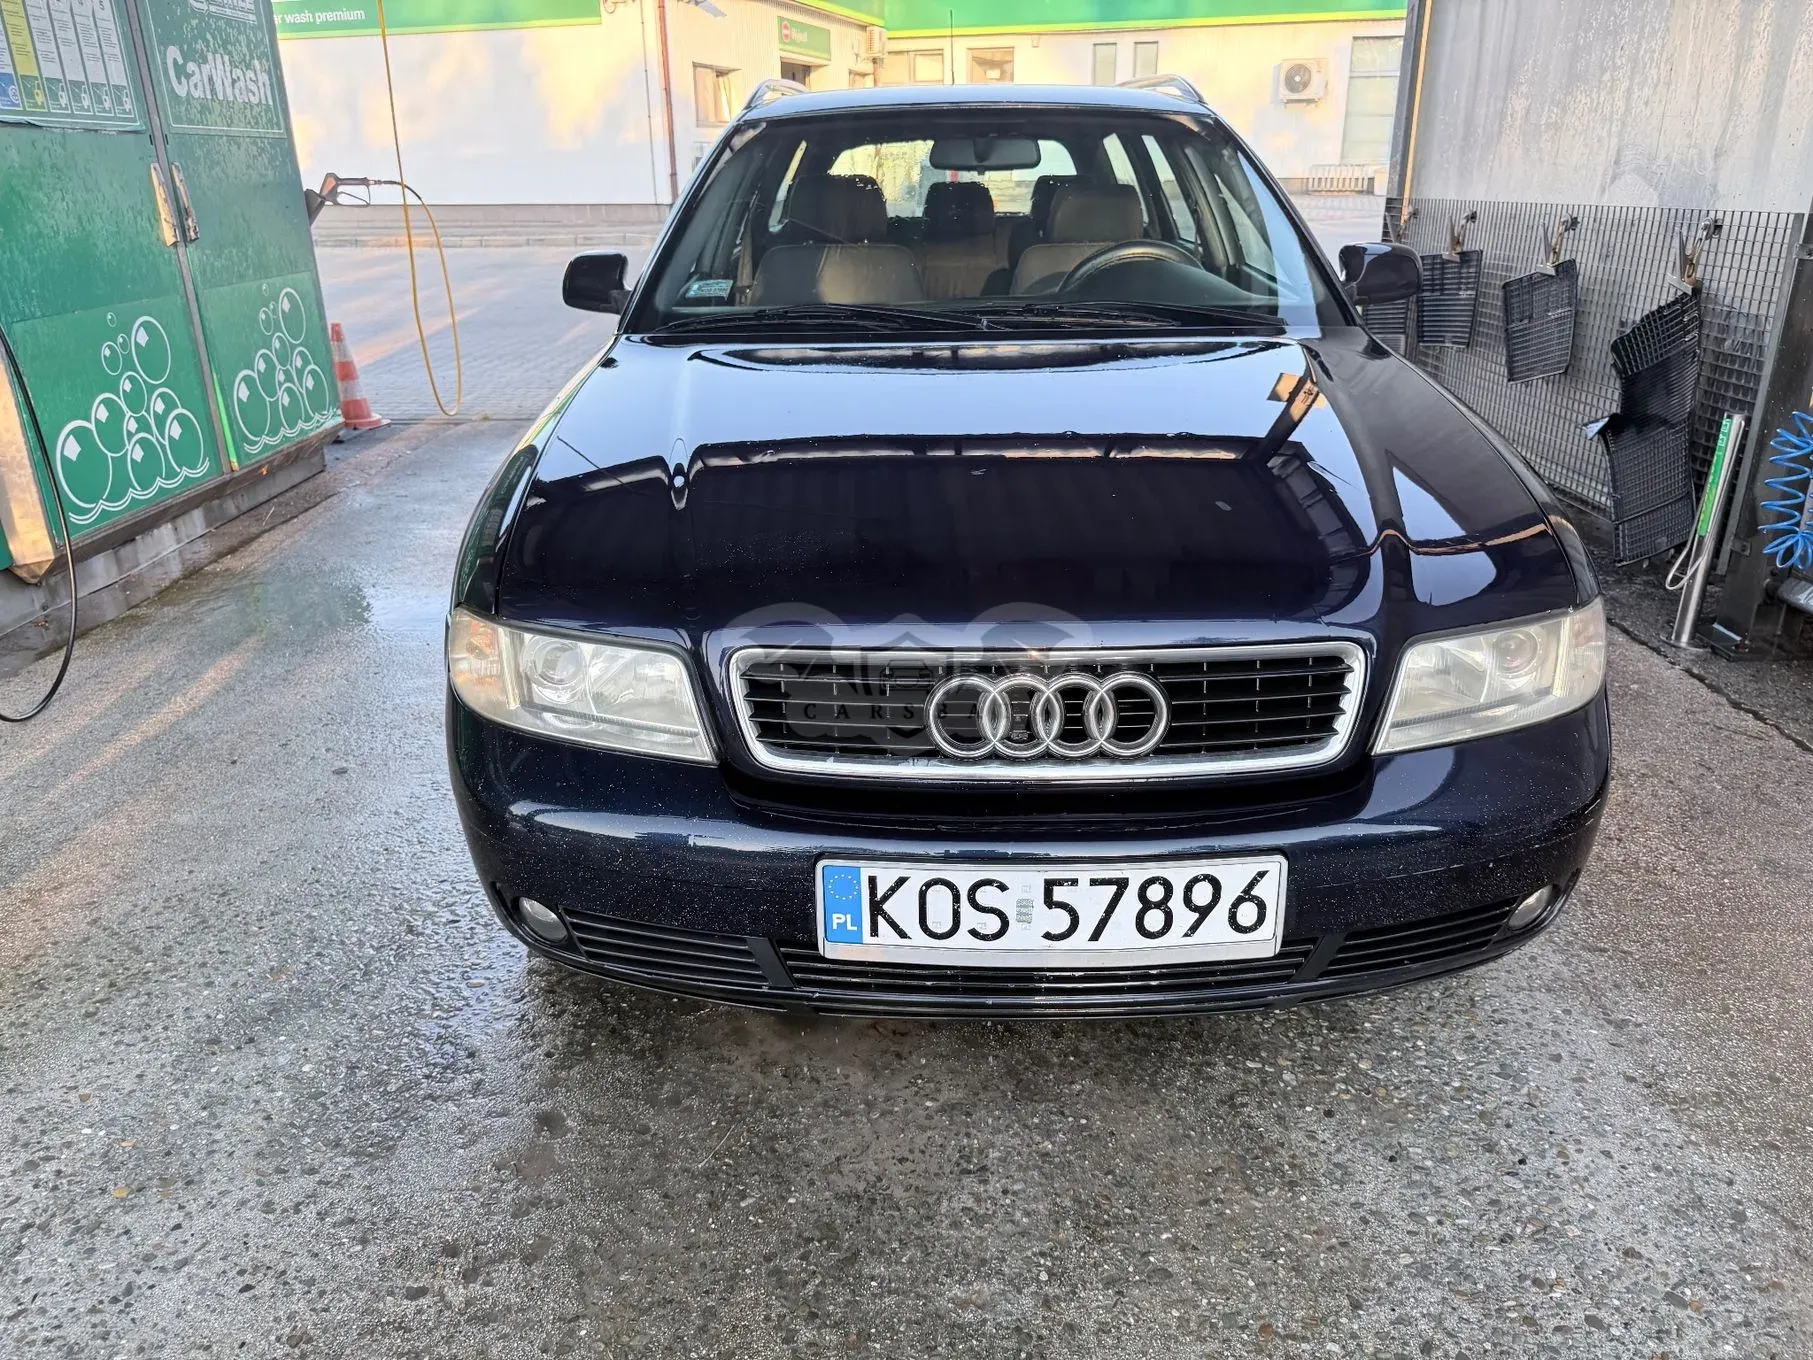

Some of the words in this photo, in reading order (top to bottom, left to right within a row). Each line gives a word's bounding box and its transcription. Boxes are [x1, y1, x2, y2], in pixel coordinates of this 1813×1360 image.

[284, 10, 313, 23] wash
[315, 8, 365, 24] premium
[167, 46, 273, 106] CarWash
[832, 914, 858, 931] PL
[868, 875, 1011, 941] KOS
[1041, 870, 1270, 942] 57896
